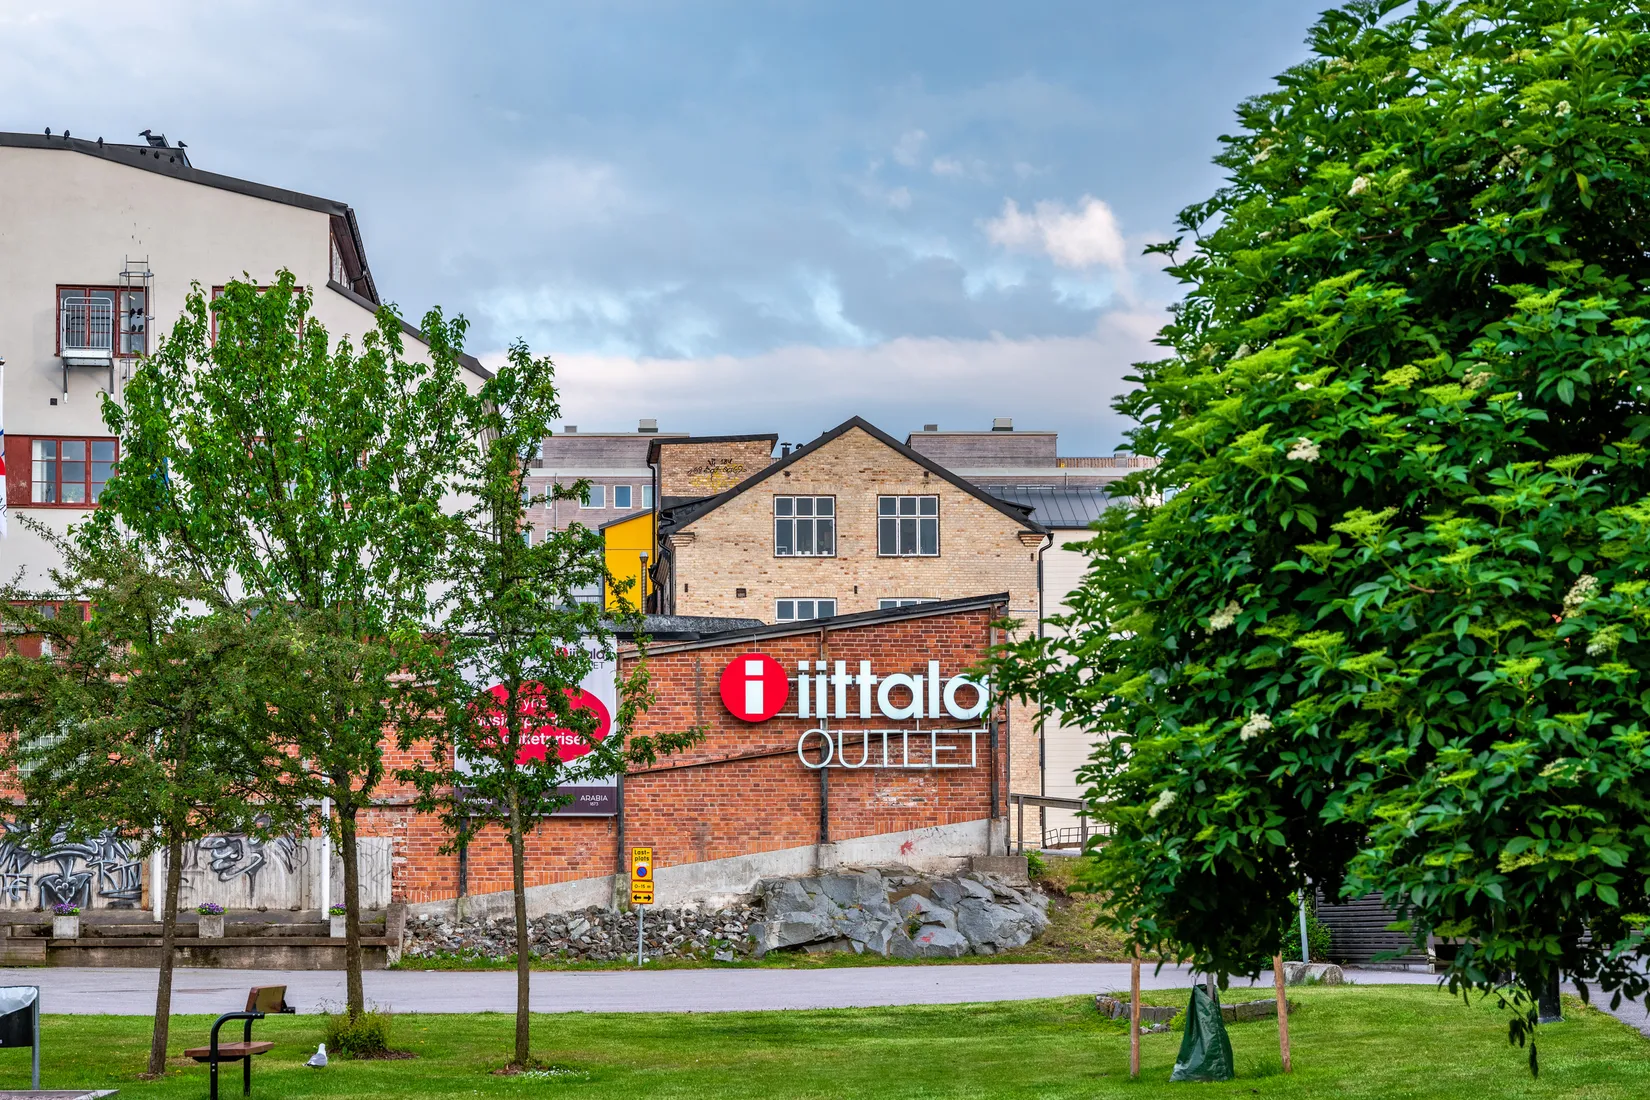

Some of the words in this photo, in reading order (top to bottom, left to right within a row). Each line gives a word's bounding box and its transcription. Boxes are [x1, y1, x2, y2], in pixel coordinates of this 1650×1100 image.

[745, 660, 764, 714] i
[798, 660, 990, 720] iittala
[797, 728, 989, 769] OUTLET
